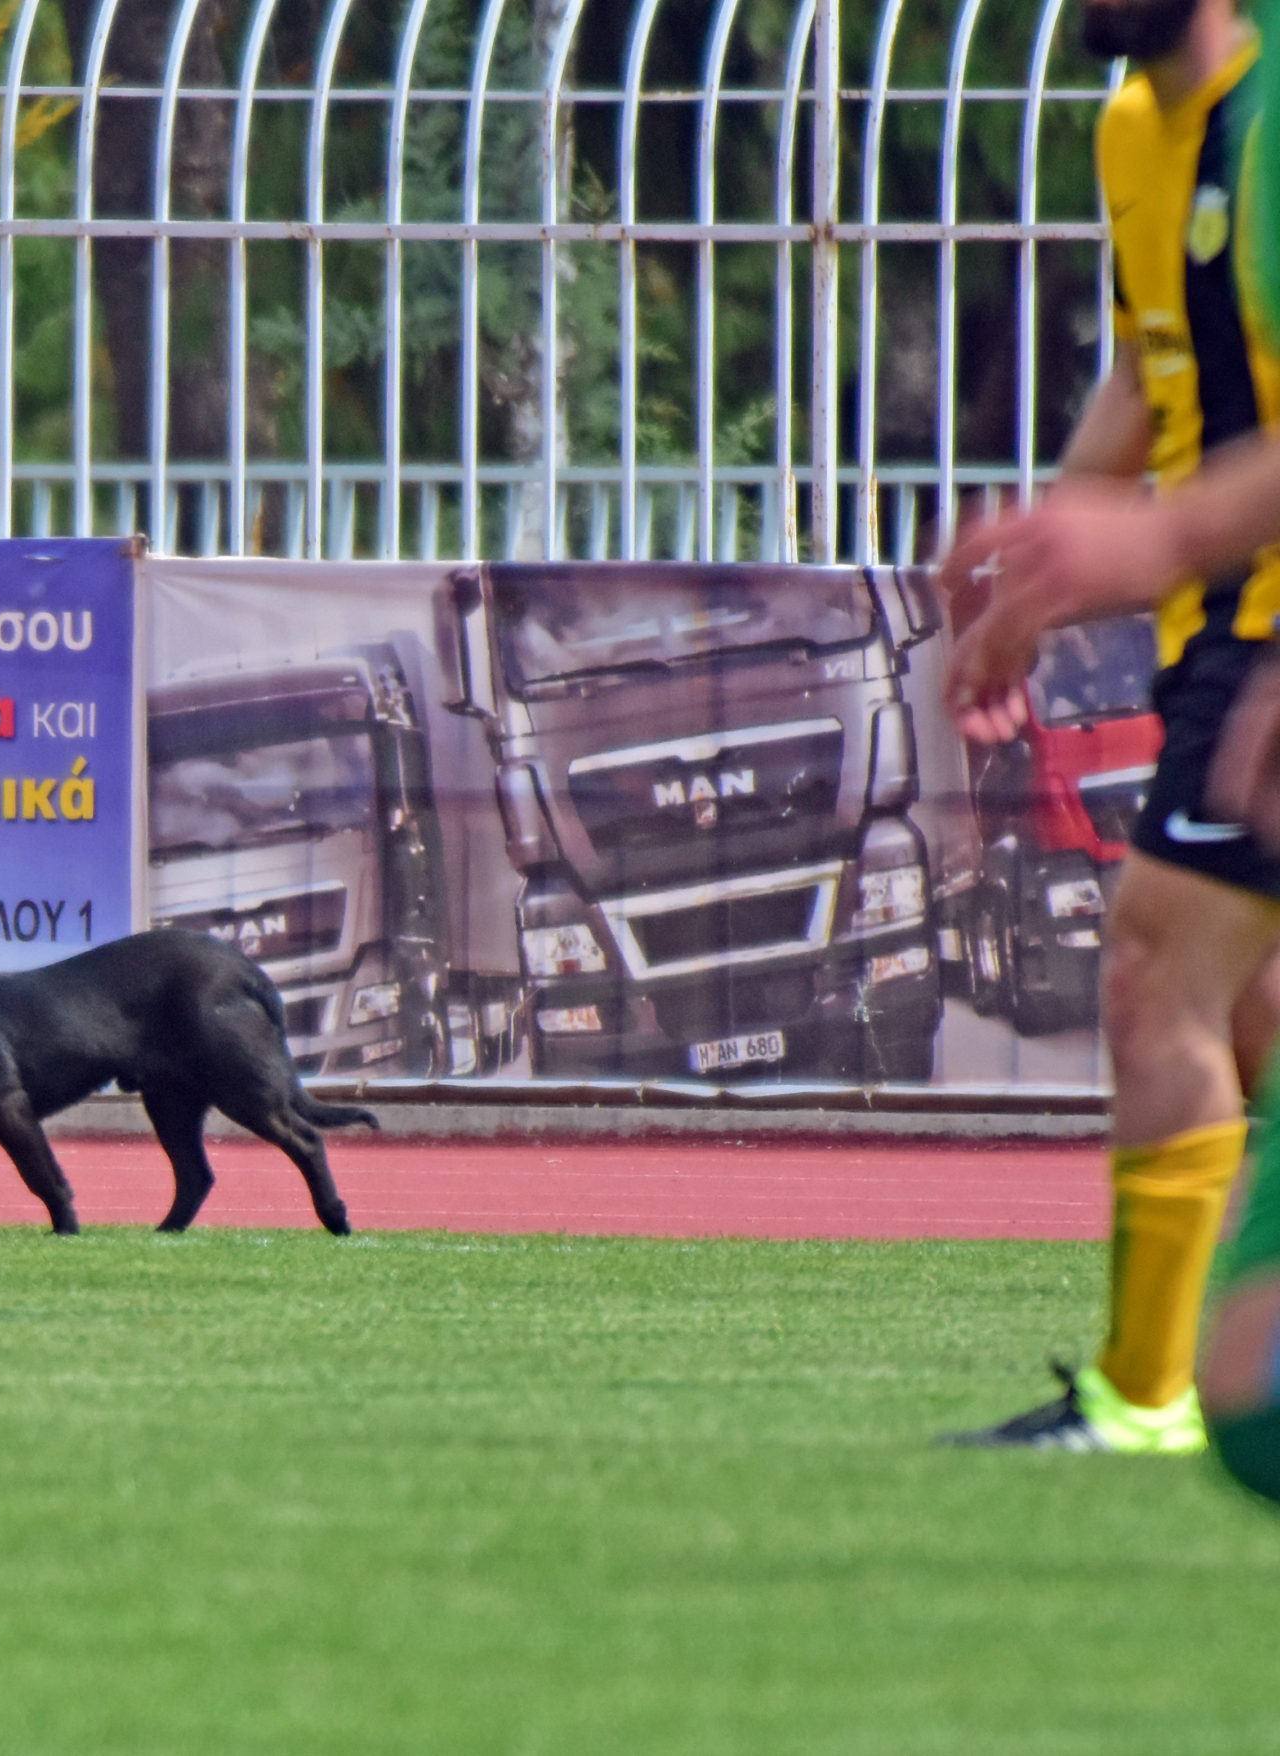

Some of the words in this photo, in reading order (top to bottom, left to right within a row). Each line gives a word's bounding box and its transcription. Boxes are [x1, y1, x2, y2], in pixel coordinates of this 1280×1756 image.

[33, 702, 96, 738] και
[653, 769, 755, 808] MAN
[78, 899, 92, 942] 1
[746, 1035, 779, 1057] 680
